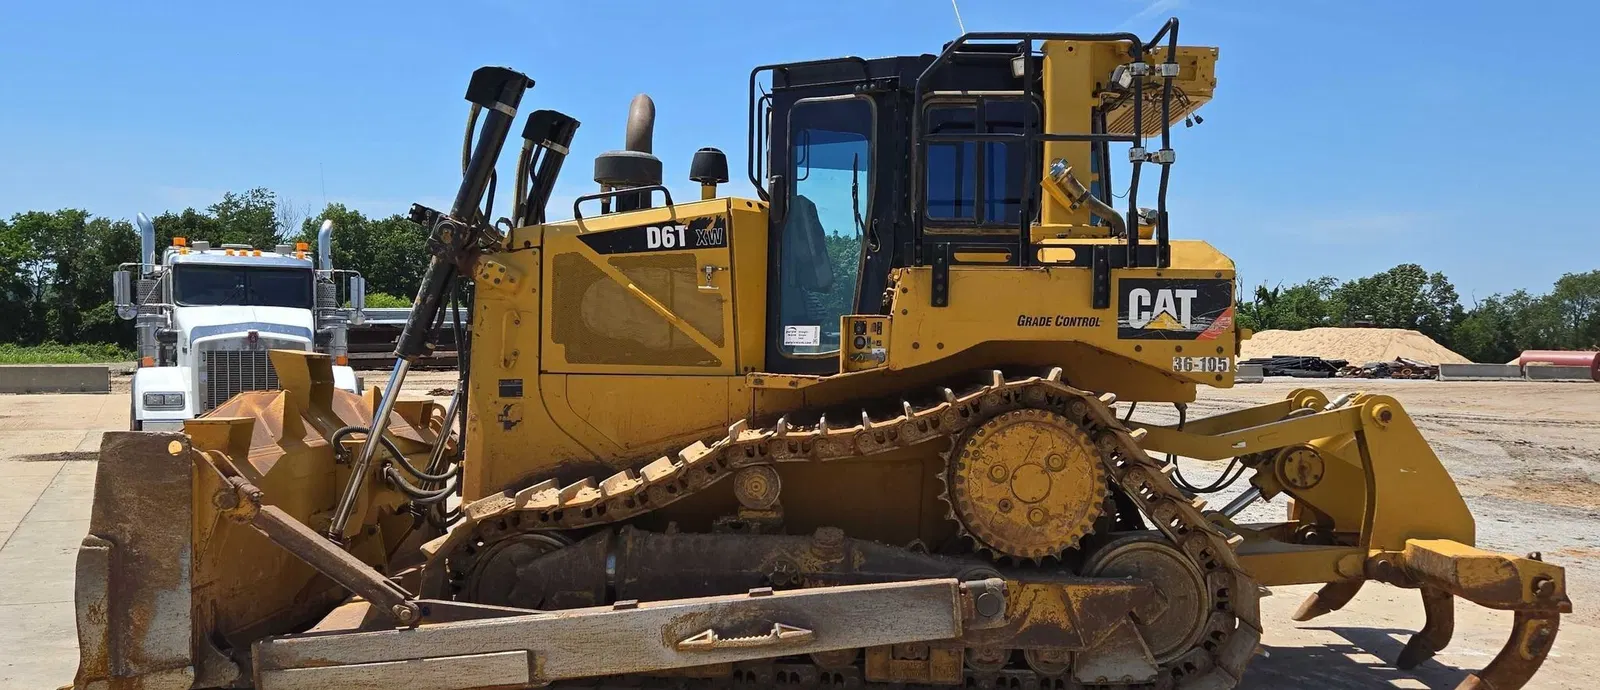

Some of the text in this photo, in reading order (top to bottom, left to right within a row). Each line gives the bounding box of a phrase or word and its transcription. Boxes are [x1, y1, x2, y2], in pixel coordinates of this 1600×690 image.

[646, 225, 723, 249] D6T XW
[1128, 287, 1197, 330] CAT
[1017, 314, 1101, 327] GRADE CONTROL
[1173, 357, 1227, 372] 36-105
